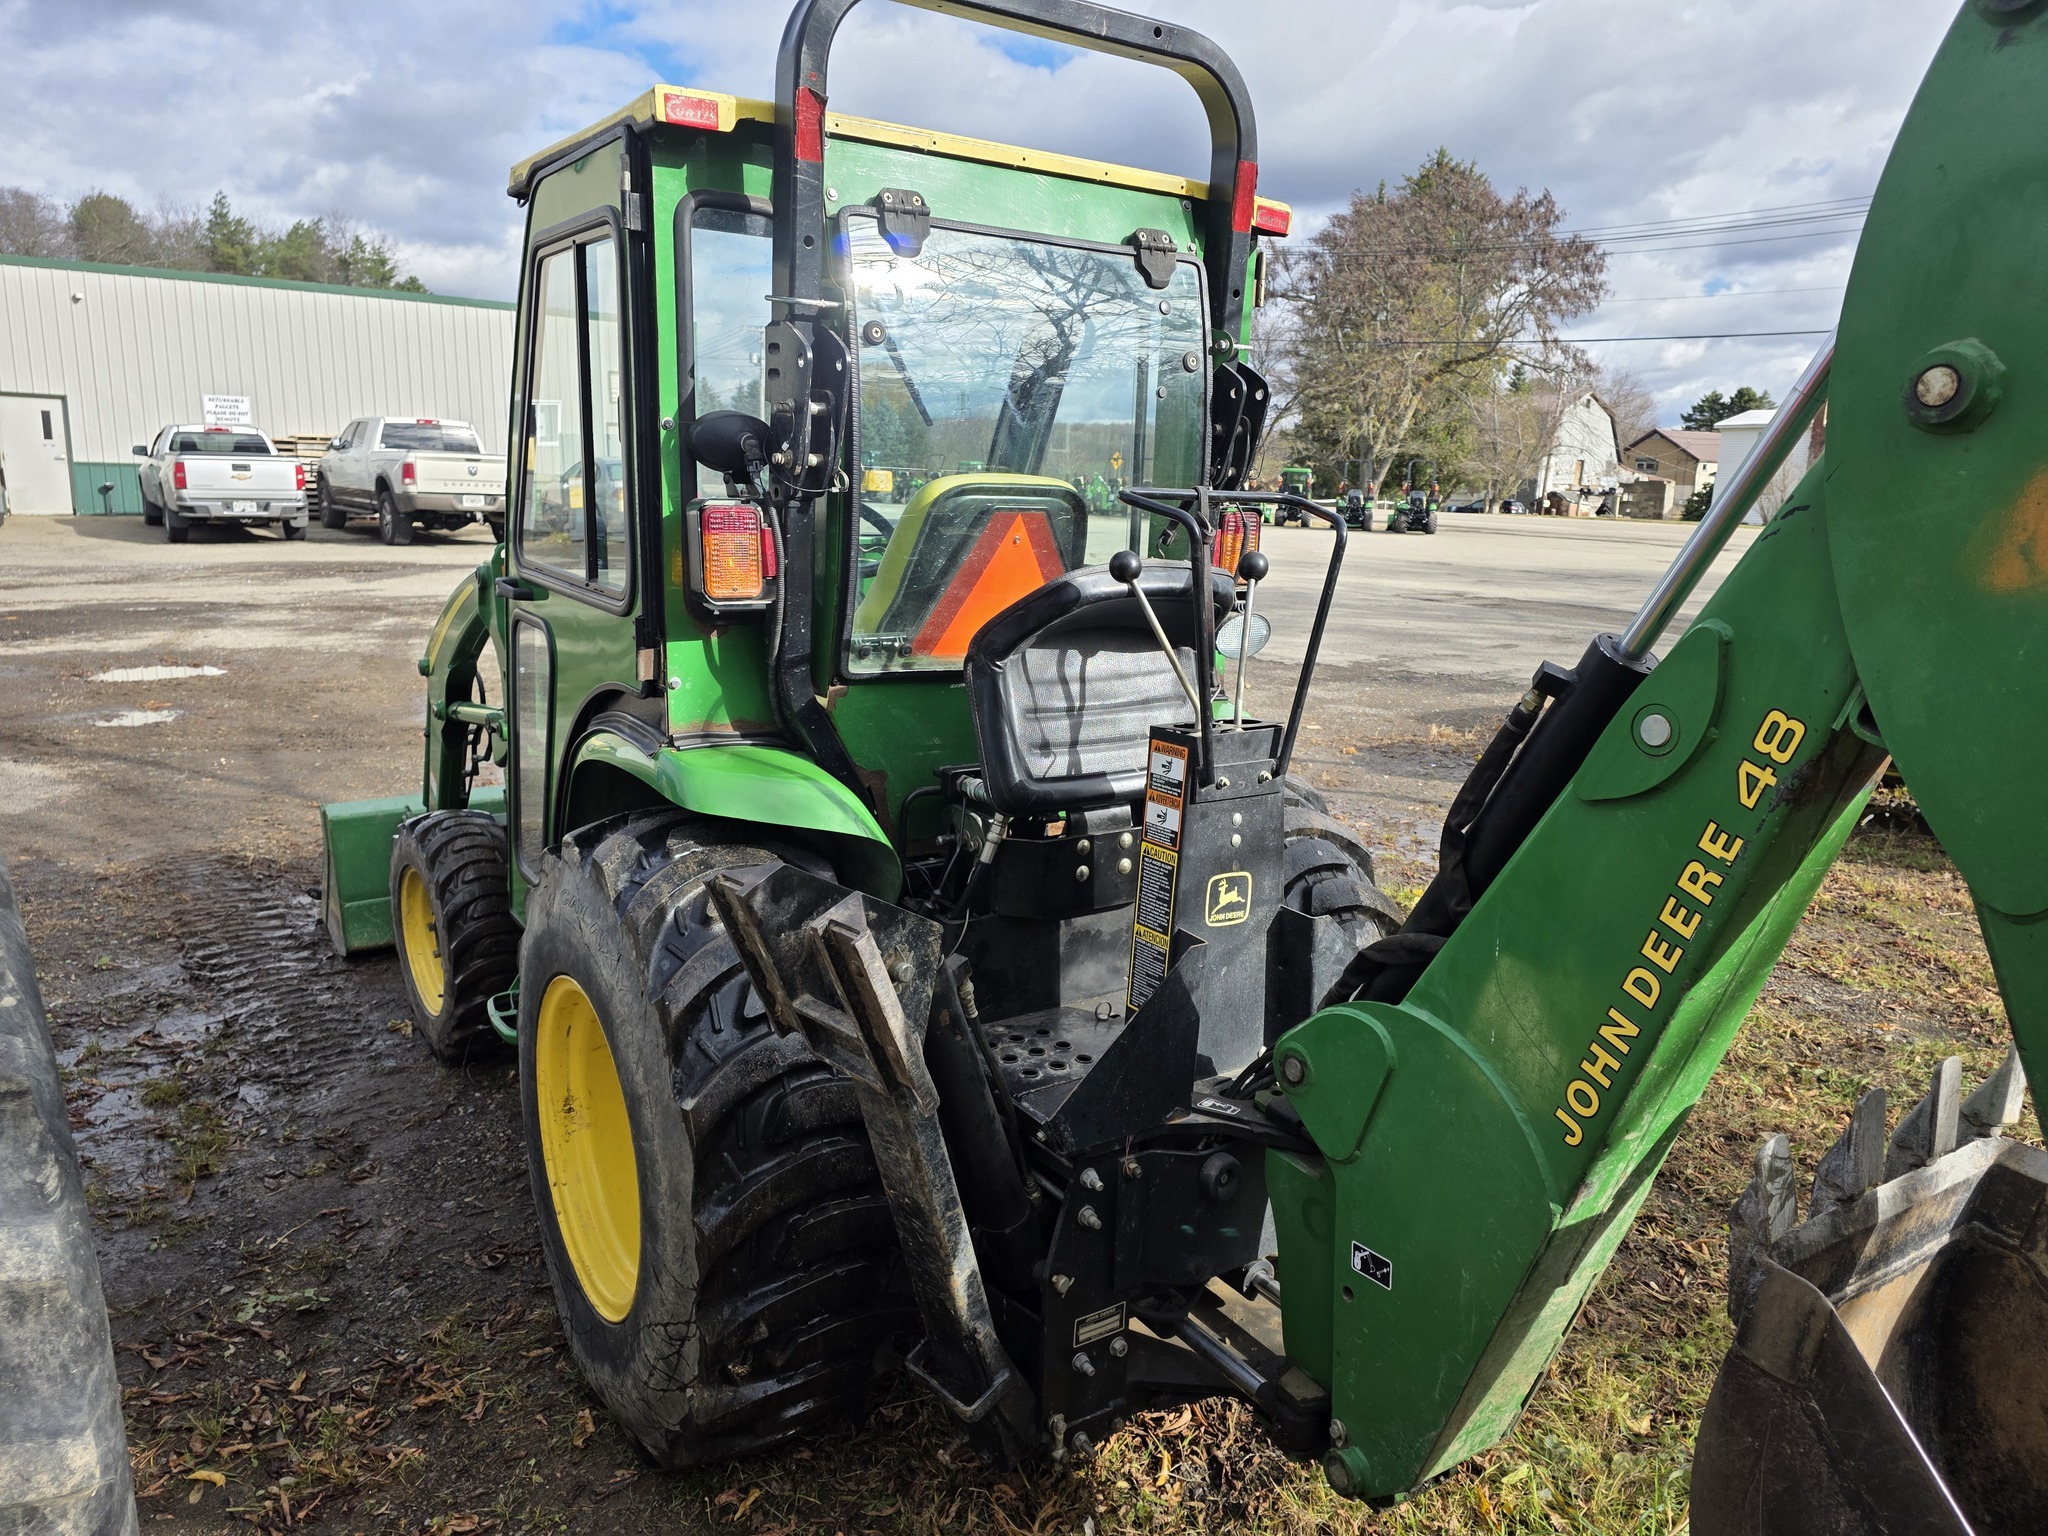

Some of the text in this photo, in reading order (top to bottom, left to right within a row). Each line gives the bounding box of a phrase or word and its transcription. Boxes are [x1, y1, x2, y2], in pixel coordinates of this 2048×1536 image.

[1161, 743, 1186, 759] WARNING
[1150, 847, 1176, 864] CAUTION
[1209, 910, 1245, 922] JOHN DEERE
[1554, 707, 1808, 1147] JOHN DEERE 48
[1142, 930, 1169, 949] ATENCION
